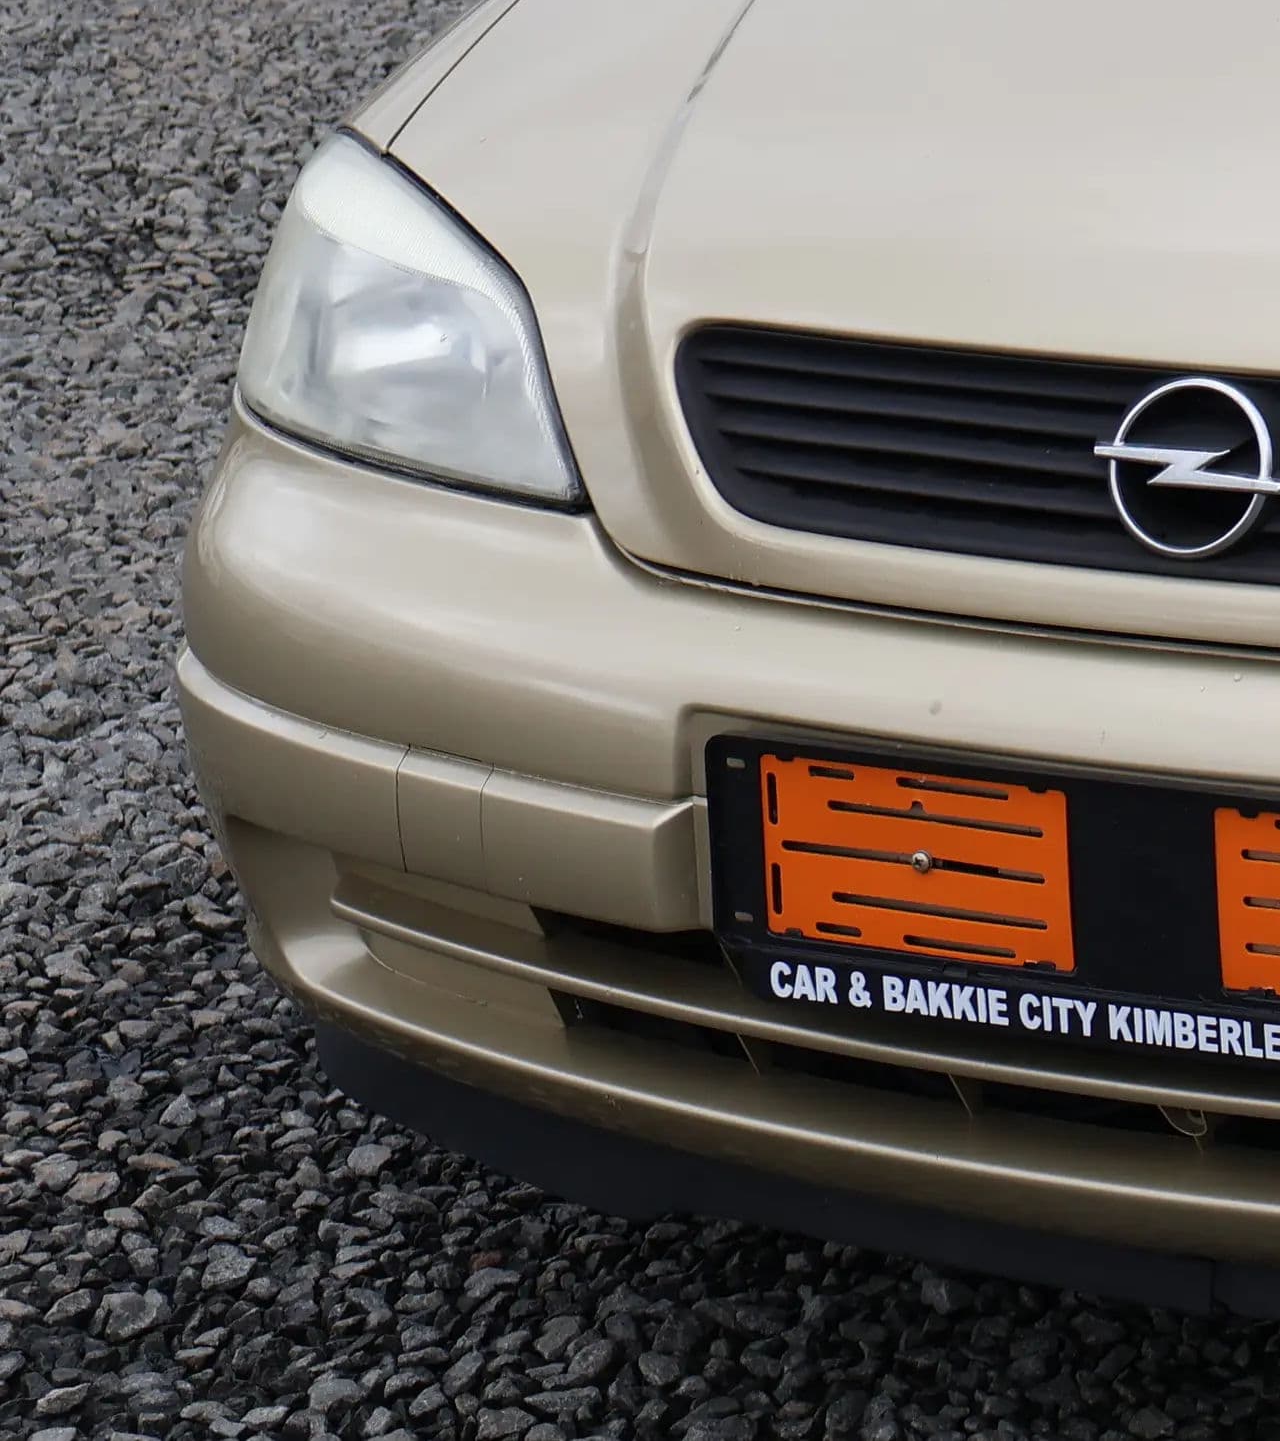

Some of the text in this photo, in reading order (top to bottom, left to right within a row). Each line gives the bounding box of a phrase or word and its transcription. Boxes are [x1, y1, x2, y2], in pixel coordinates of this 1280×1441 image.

[770, 961, 838, 1004] CAR
[848, 971, 873, 1008] &
[882, 975, 1010, 1026] BAKKIE
[1018, 993, 1097, 1038] CITY
